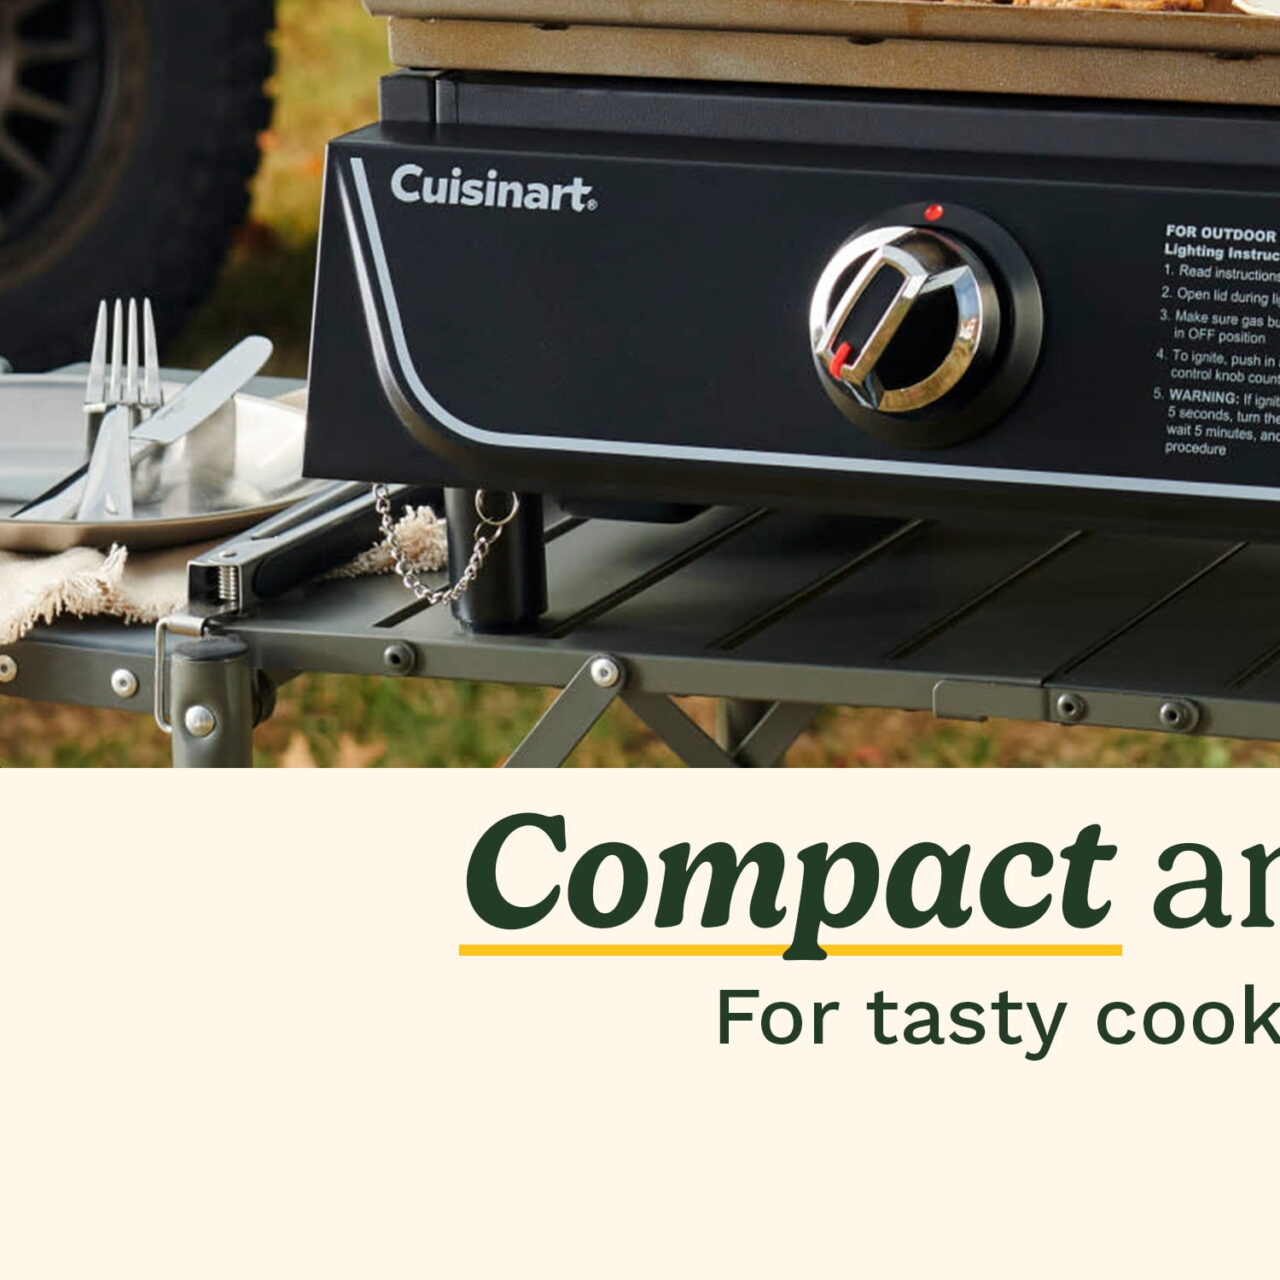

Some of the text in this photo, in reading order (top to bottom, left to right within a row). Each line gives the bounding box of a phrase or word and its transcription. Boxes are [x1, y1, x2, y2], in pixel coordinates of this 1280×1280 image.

[1166, 225, 1197, 237] FOR
[1201, 226, 1276, 243] OUTDOOR
[1165, 243, 1224, 260] Lighting
[1179, 265, 1211, 278] Read
[1162, 287, 1172, 298] 2.
[1177, 287, 1210, 302] Open
[1214, 290, 1228, 301] lid
[1230, 290, 1268, 307] during
[1176, 310, 1208, 323] Make
[1212, 314, 1238, 325] sure
[1242, 316, 1264, 328] gas
[1174, 327, 1266, 345] in OFF position
[1173, 349, 1188, 361] To
[1231, 354, 1261, 368] push
[1265, 356, 1275, 367] in
[1171, 365, 1212, 379] control
[1215, 369, 1245, 382] knob
[1170, 388, 1240, 404] WARNING:
[1244, 393, 1253, 404] If
[1168, 405, 1176, 417] 5
[1237, 411, 1260, 423] turn
[1167, 423, 1191, 437] wait
[1194, 425, 1203, 437] 5
[1165, 441, 1227, 455] procedure
